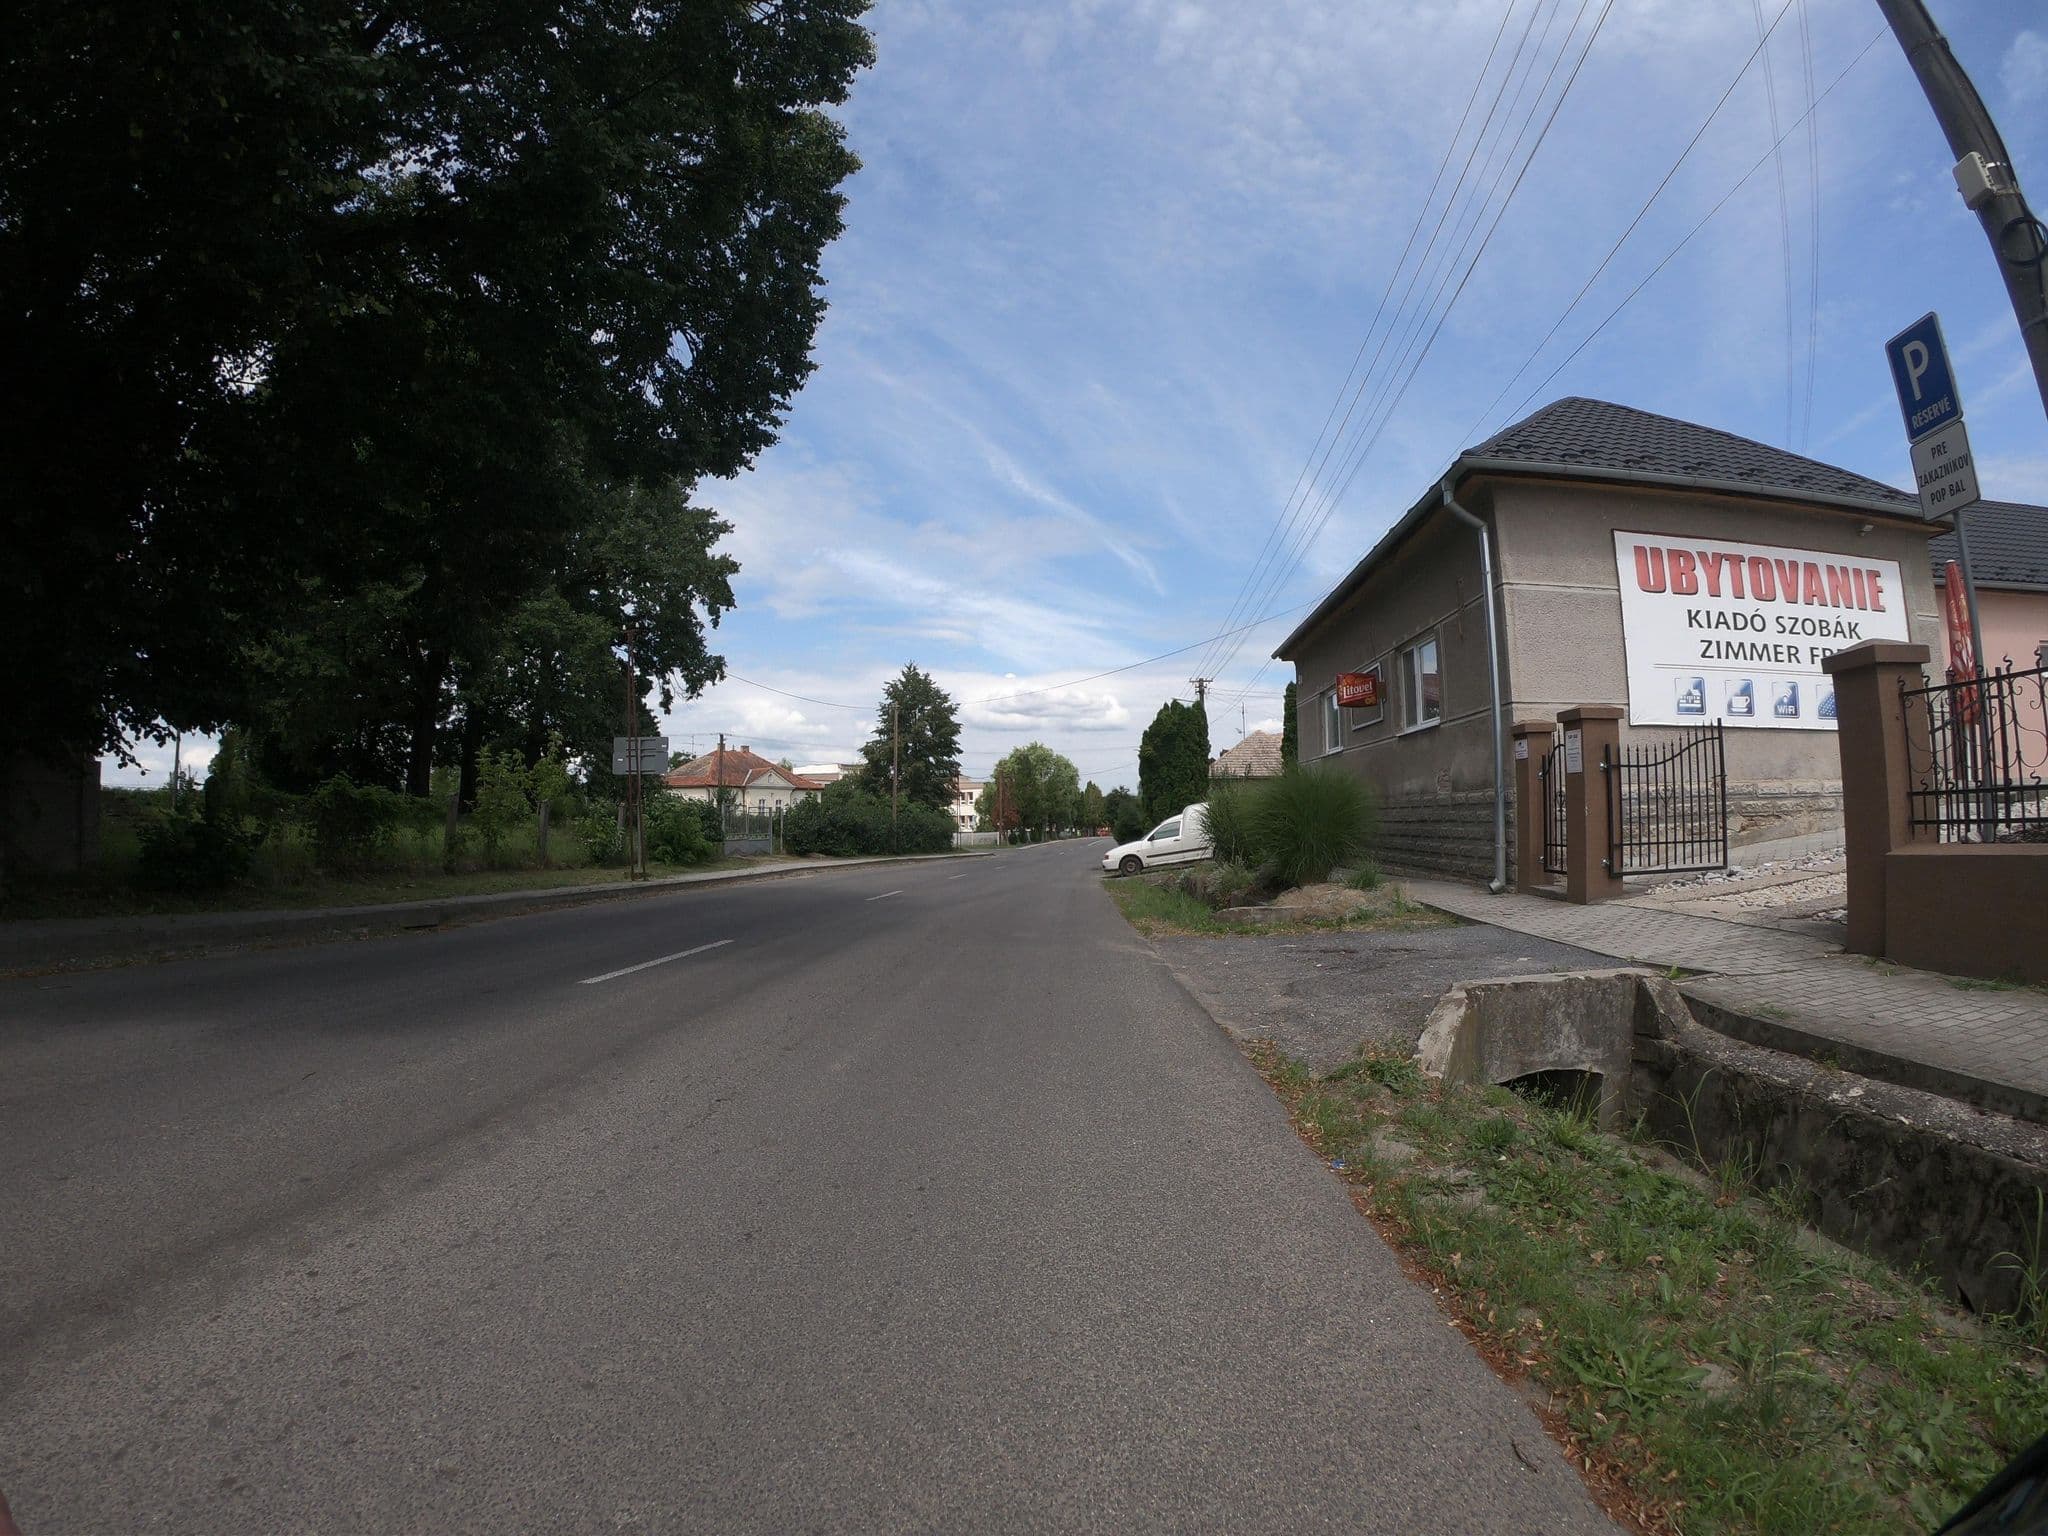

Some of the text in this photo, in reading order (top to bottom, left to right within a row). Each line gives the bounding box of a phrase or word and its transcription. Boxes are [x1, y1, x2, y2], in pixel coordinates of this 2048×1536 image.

[1902, 340, 1929, 400] P
[1930, 441, 1948, 459] PRE
[1930, 479, 1966, 505] POP BAL
[1633, 545, 1886, 612] UBYTOVANIE
[1687, 608, 1862, 640] KIADÓ SZOBÁK
[1699, 639, 1802, 664] ZIMMER
[1343, 680, 1373, 699] Litovel
